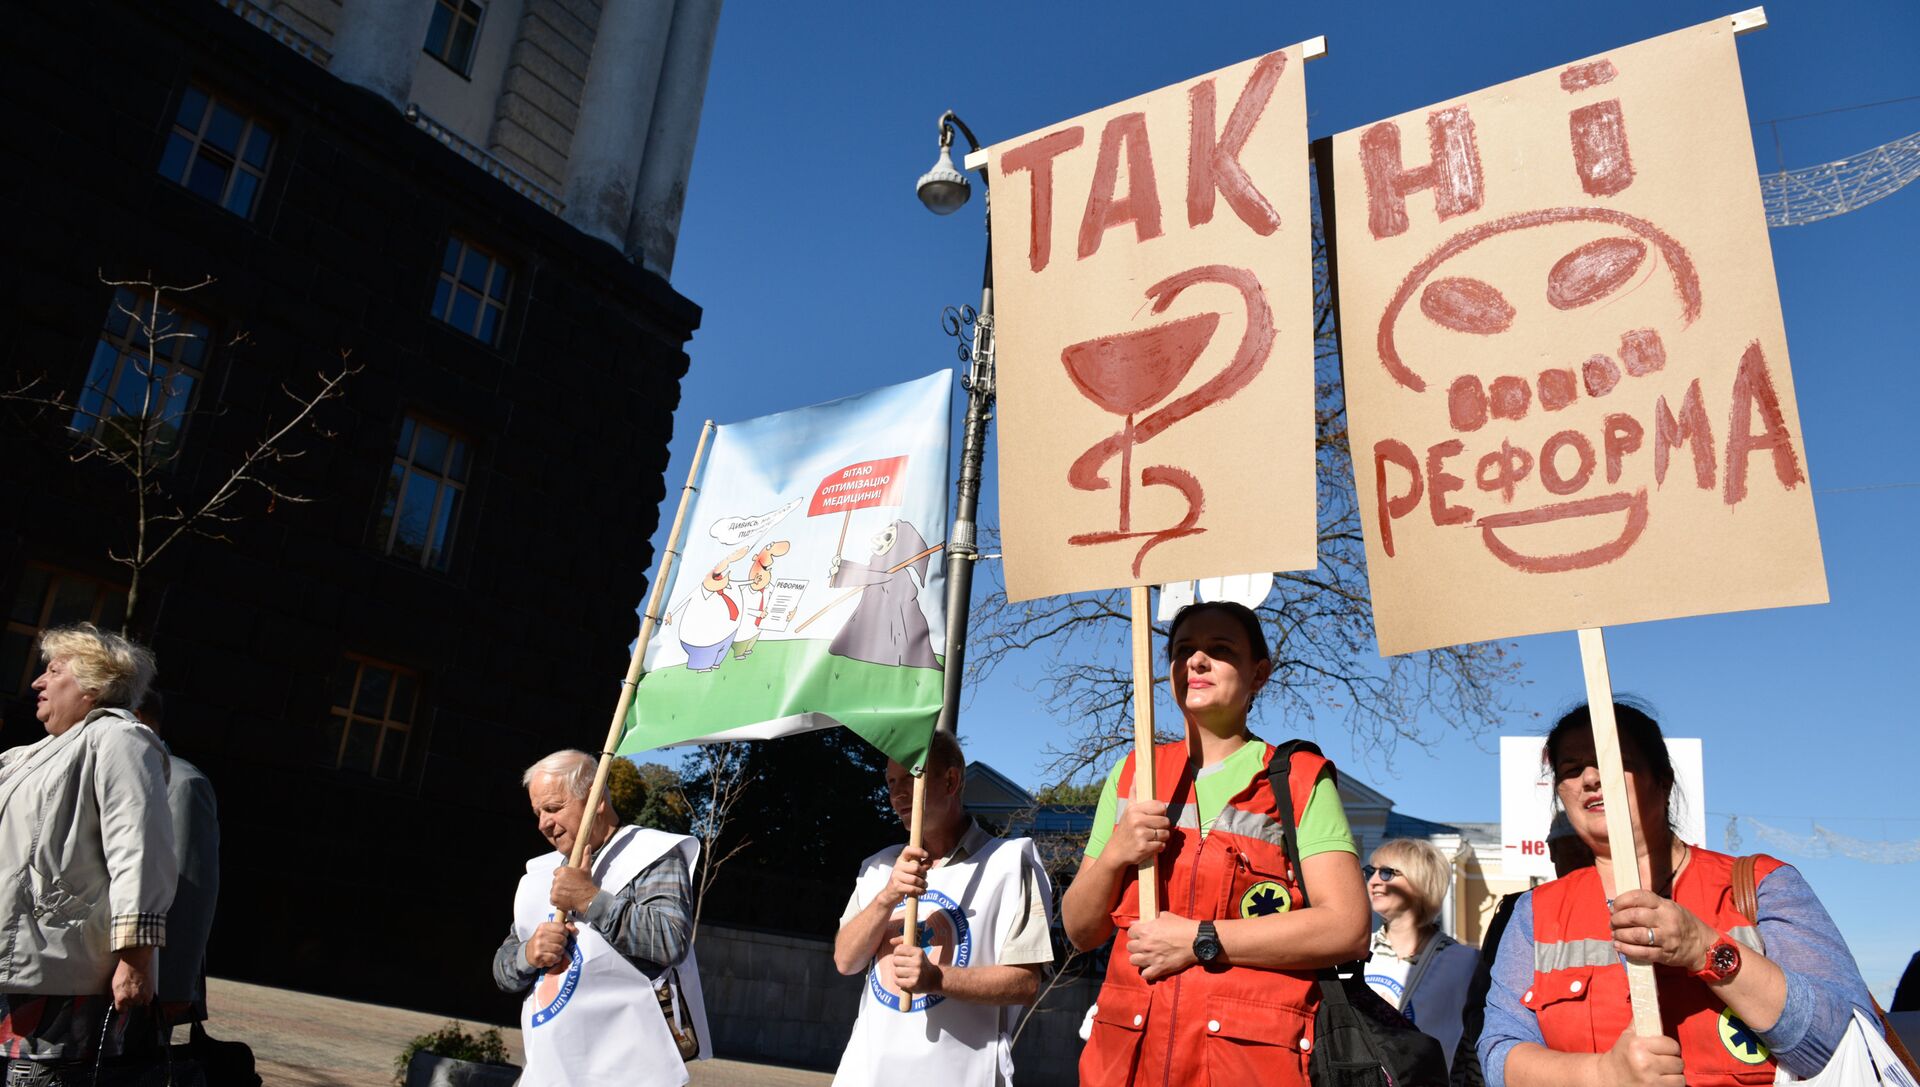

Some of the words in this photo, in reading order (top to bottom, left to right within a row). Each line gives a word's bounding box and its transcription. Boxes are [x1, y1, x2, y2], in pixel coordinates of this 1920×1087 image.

[1359, 58, 1638, 241] НІ
[1000, 50, 1288, 274] ТАК
[1373, 338, 1806, 557] РЕФОРМА
[843, 465, 873, 479] ВІТАЮ
[822, 475, 890, 495] ОПТИМІЗАЦІЮ
[822, 489, 882, 507] МЕДИЦИНИ!
[776, 581, 805, 591] РЕФОРМИ
